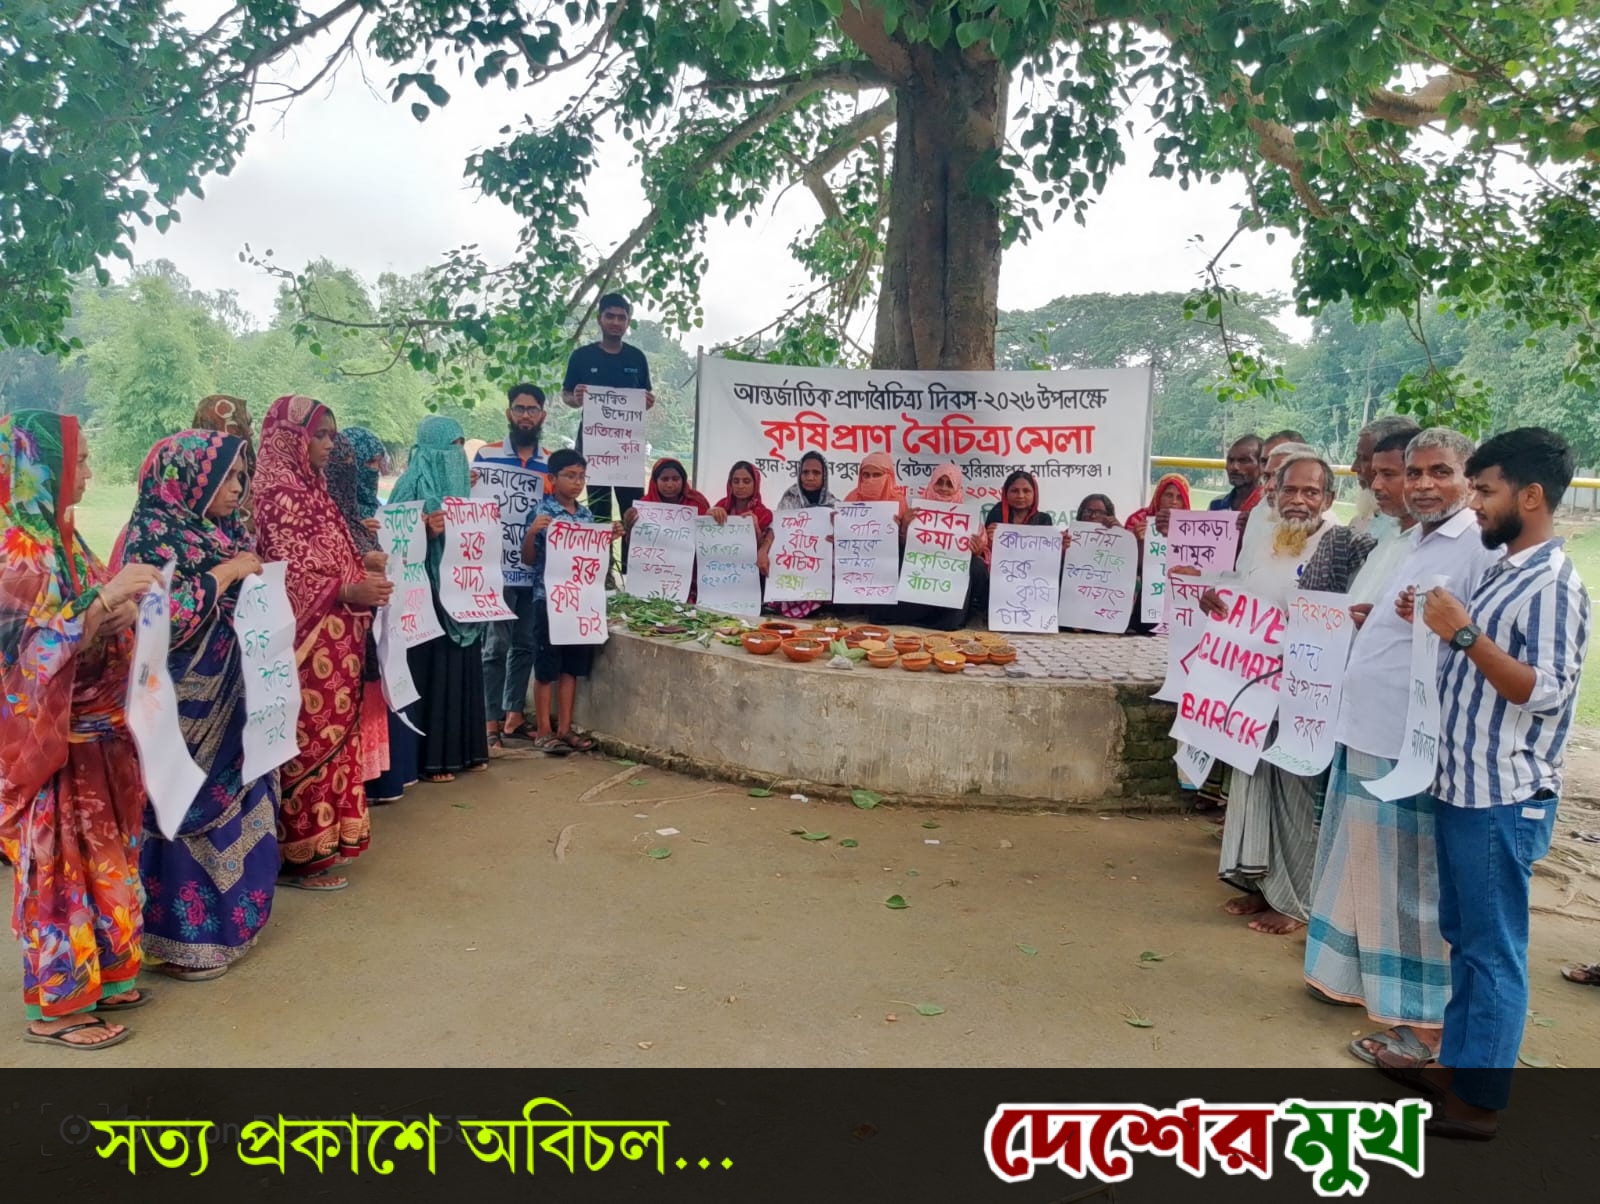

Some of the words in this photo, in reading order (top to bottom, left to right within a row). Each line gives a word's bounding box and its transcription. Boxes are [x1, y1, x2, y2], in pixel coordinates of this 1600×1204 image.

[734, 379, 833, 408] আন্তর্জাতিক
[1038, 383, 1110, 410] উপলক্ষে
[761, 410, 830, 461] কৃষি
[831, 424, 896, 454] প্রাণ
[902, 411, 1013, 457] বৈচিত্র্য
[1015, 425, 1096, 455] মেলা
[914, 506, 970, 531] কার্বন
[914, 528, 971, 551] কমাও
[904, 551, 969, 573] প্রকৃতিকে
[1197, 632, 1283, 692] CLIMATE
[1181, 692, 1267, 748] BARCIK
